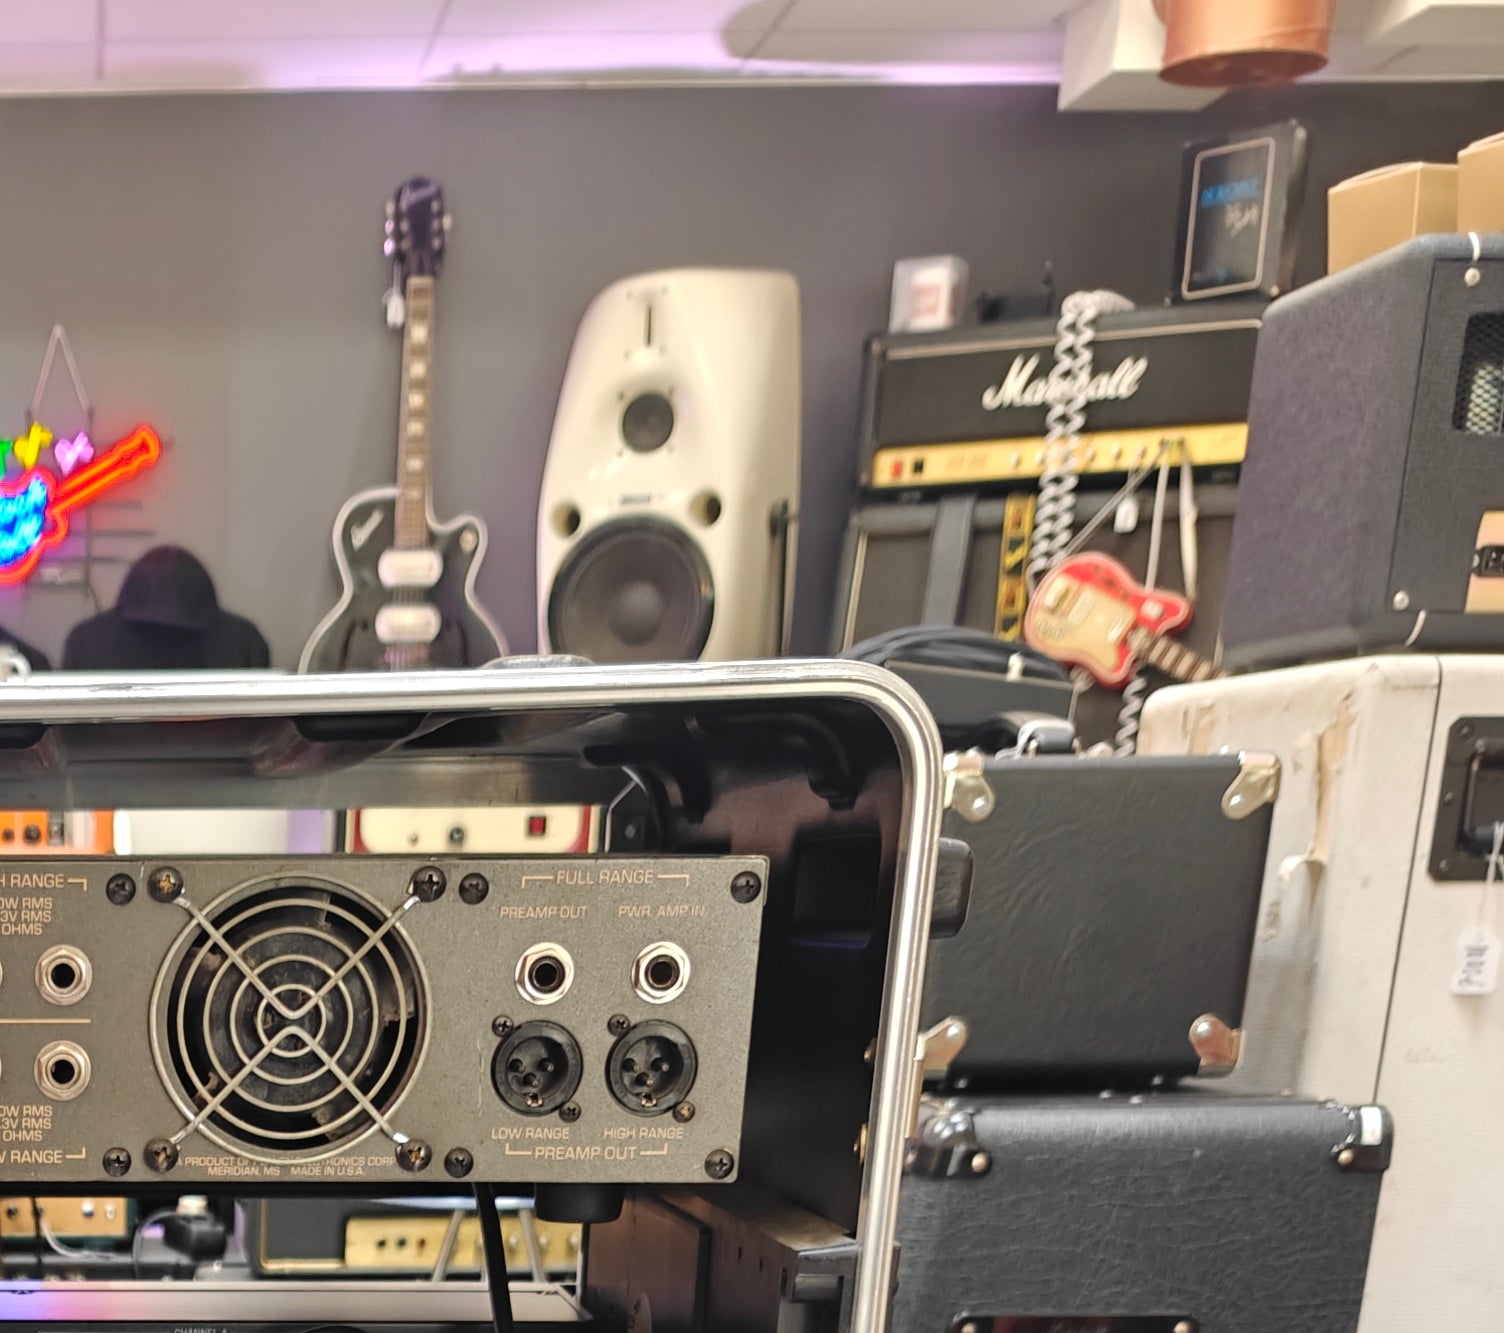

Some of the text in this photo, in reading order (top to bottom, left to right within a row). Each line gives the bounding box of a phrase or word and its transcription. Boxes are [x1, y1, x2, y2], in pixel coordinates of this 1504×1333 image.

[982, 352, 1147, 411] Maall
[11, 874, 64, 888] RANGE
[557, 870, 653, 885] FULL RANGE
[22, 898, 52, 909] RMS
[22, 911, 51, 922] RMS
[500, 906, 587, 918] PREAMP OUT
[657, 906, 687, 917] AMP
[692, 906, 704, 916] IN
[2, 924, 42, 935] OHMS
[23, 1106, 52, 1117] RMS
[22, 1118, 51, 1129] RMS
[3, 1131, 42, 1141] OHMS
[491, 1127, 569, 1139] LOW RANGE
[604, 1127, 683, 1139] HIGH RANGE
[11, 1150, 62, 1164] RANGE
[535, 1147, 637, 1160] PREAMP OUT
[264, 1167, 280, 1176] MS
[291, 1167, 320, 1176] MADE
[323, 1167, 335, 1176] IN
